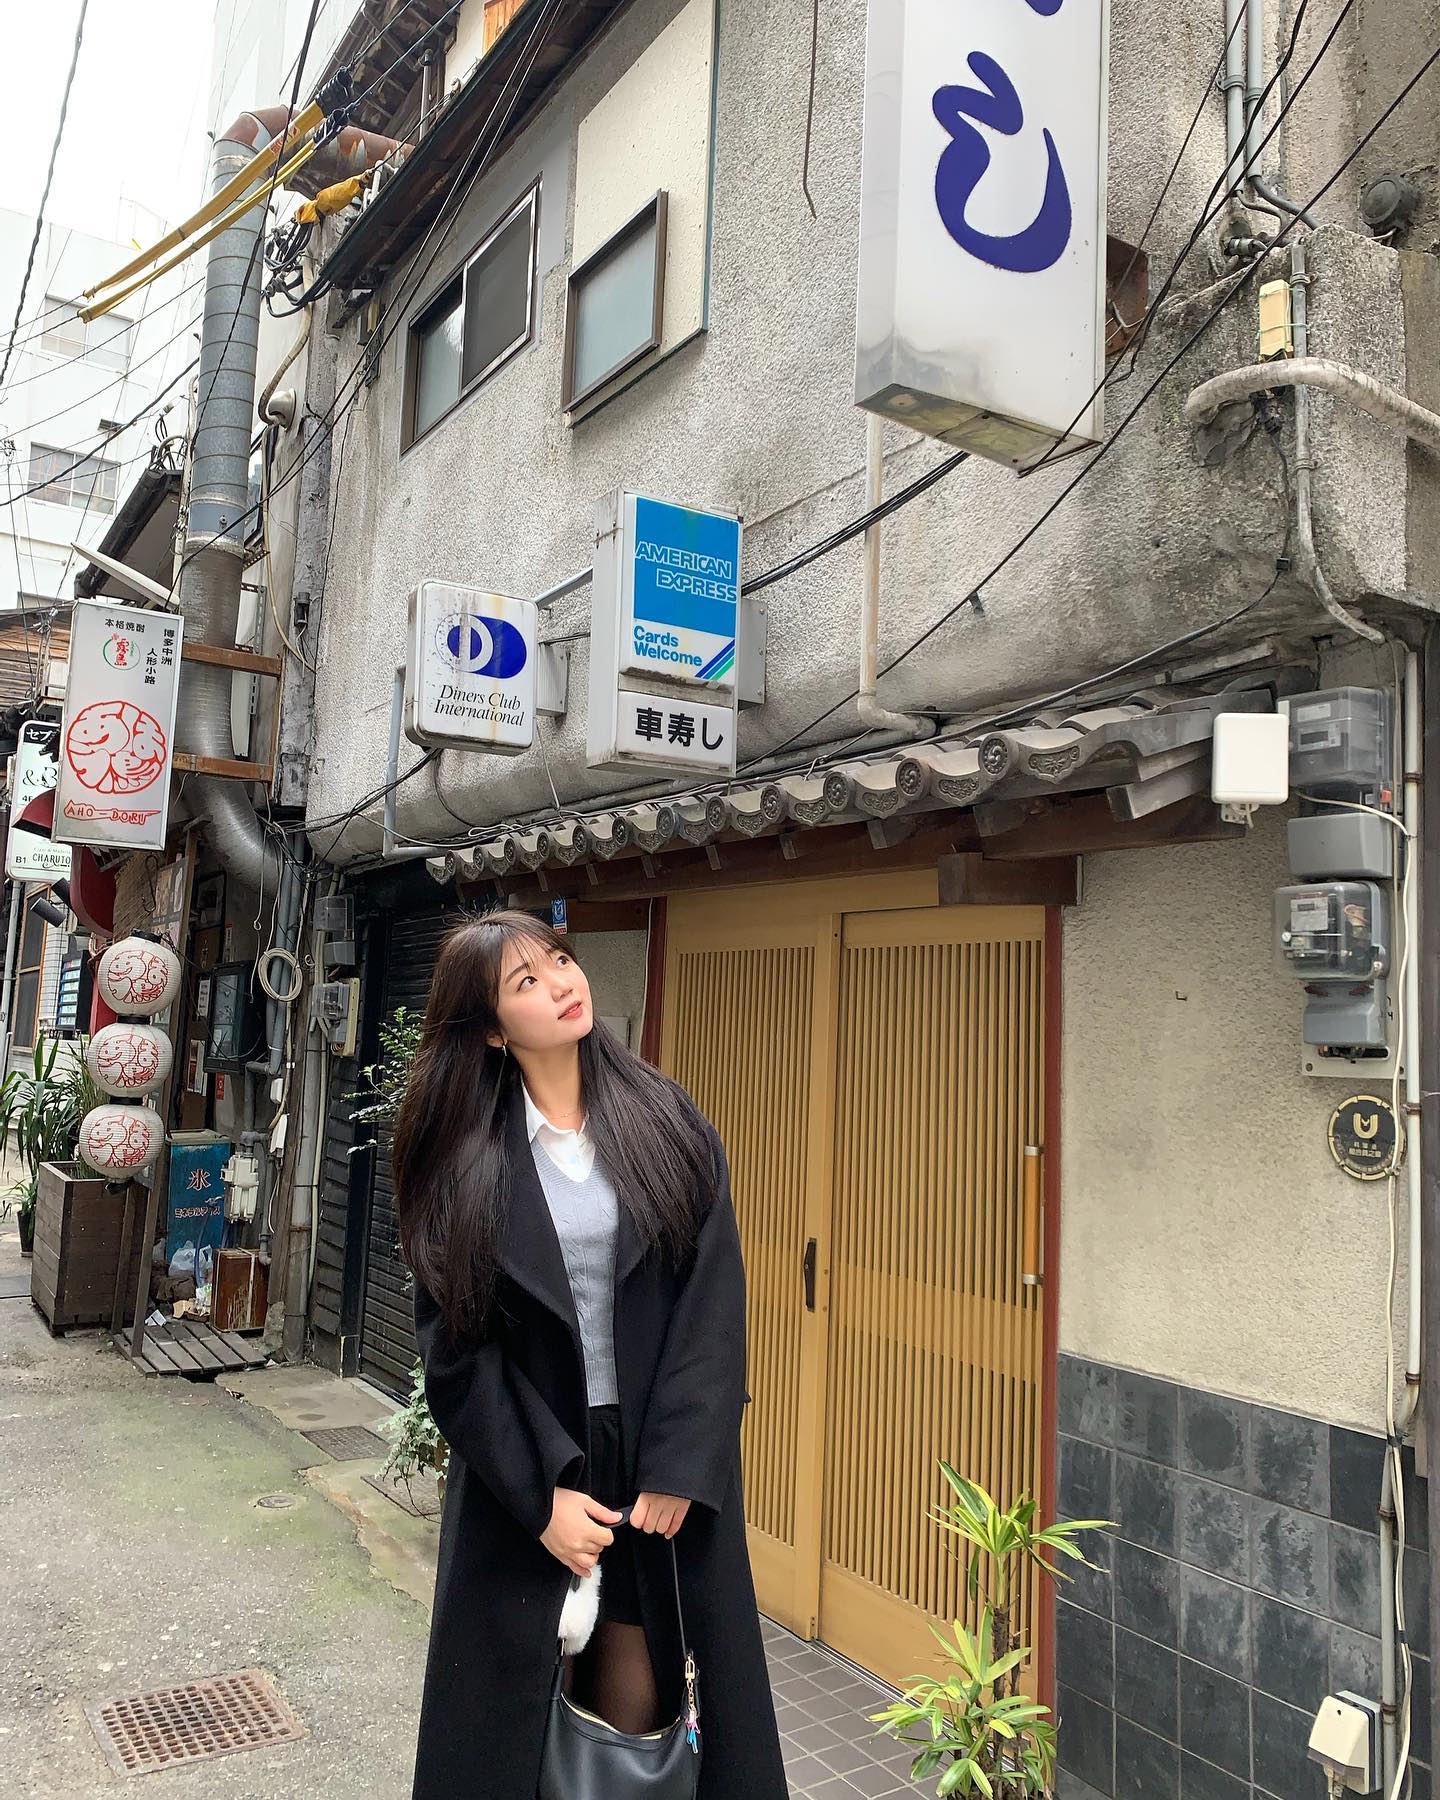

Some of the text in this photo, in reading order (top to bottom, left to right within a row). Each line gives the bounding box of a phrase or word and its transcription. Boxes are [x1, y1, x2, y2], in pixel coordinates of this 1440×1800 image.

[635, 541, 732, 579] AMERICAN
[656, 569, 737, 603] EXPRESS
[105, 618, 145, 633] 本格焼酎
[633, 625, 679, 648] Cards
[160, 628, 175, 666] 博多中洲
[633, 642, 703, 668] Welcome
[144, 647, 158, 685] 人形小路
[439, 684, 521, 710] Diners Club
[434, 699, 525, 727] International
[635, 707, 724, 750] 車寿し
[15, 852, 71, 867] B1 CHARUTO
[186, 1168, 212, 1191] 氷
